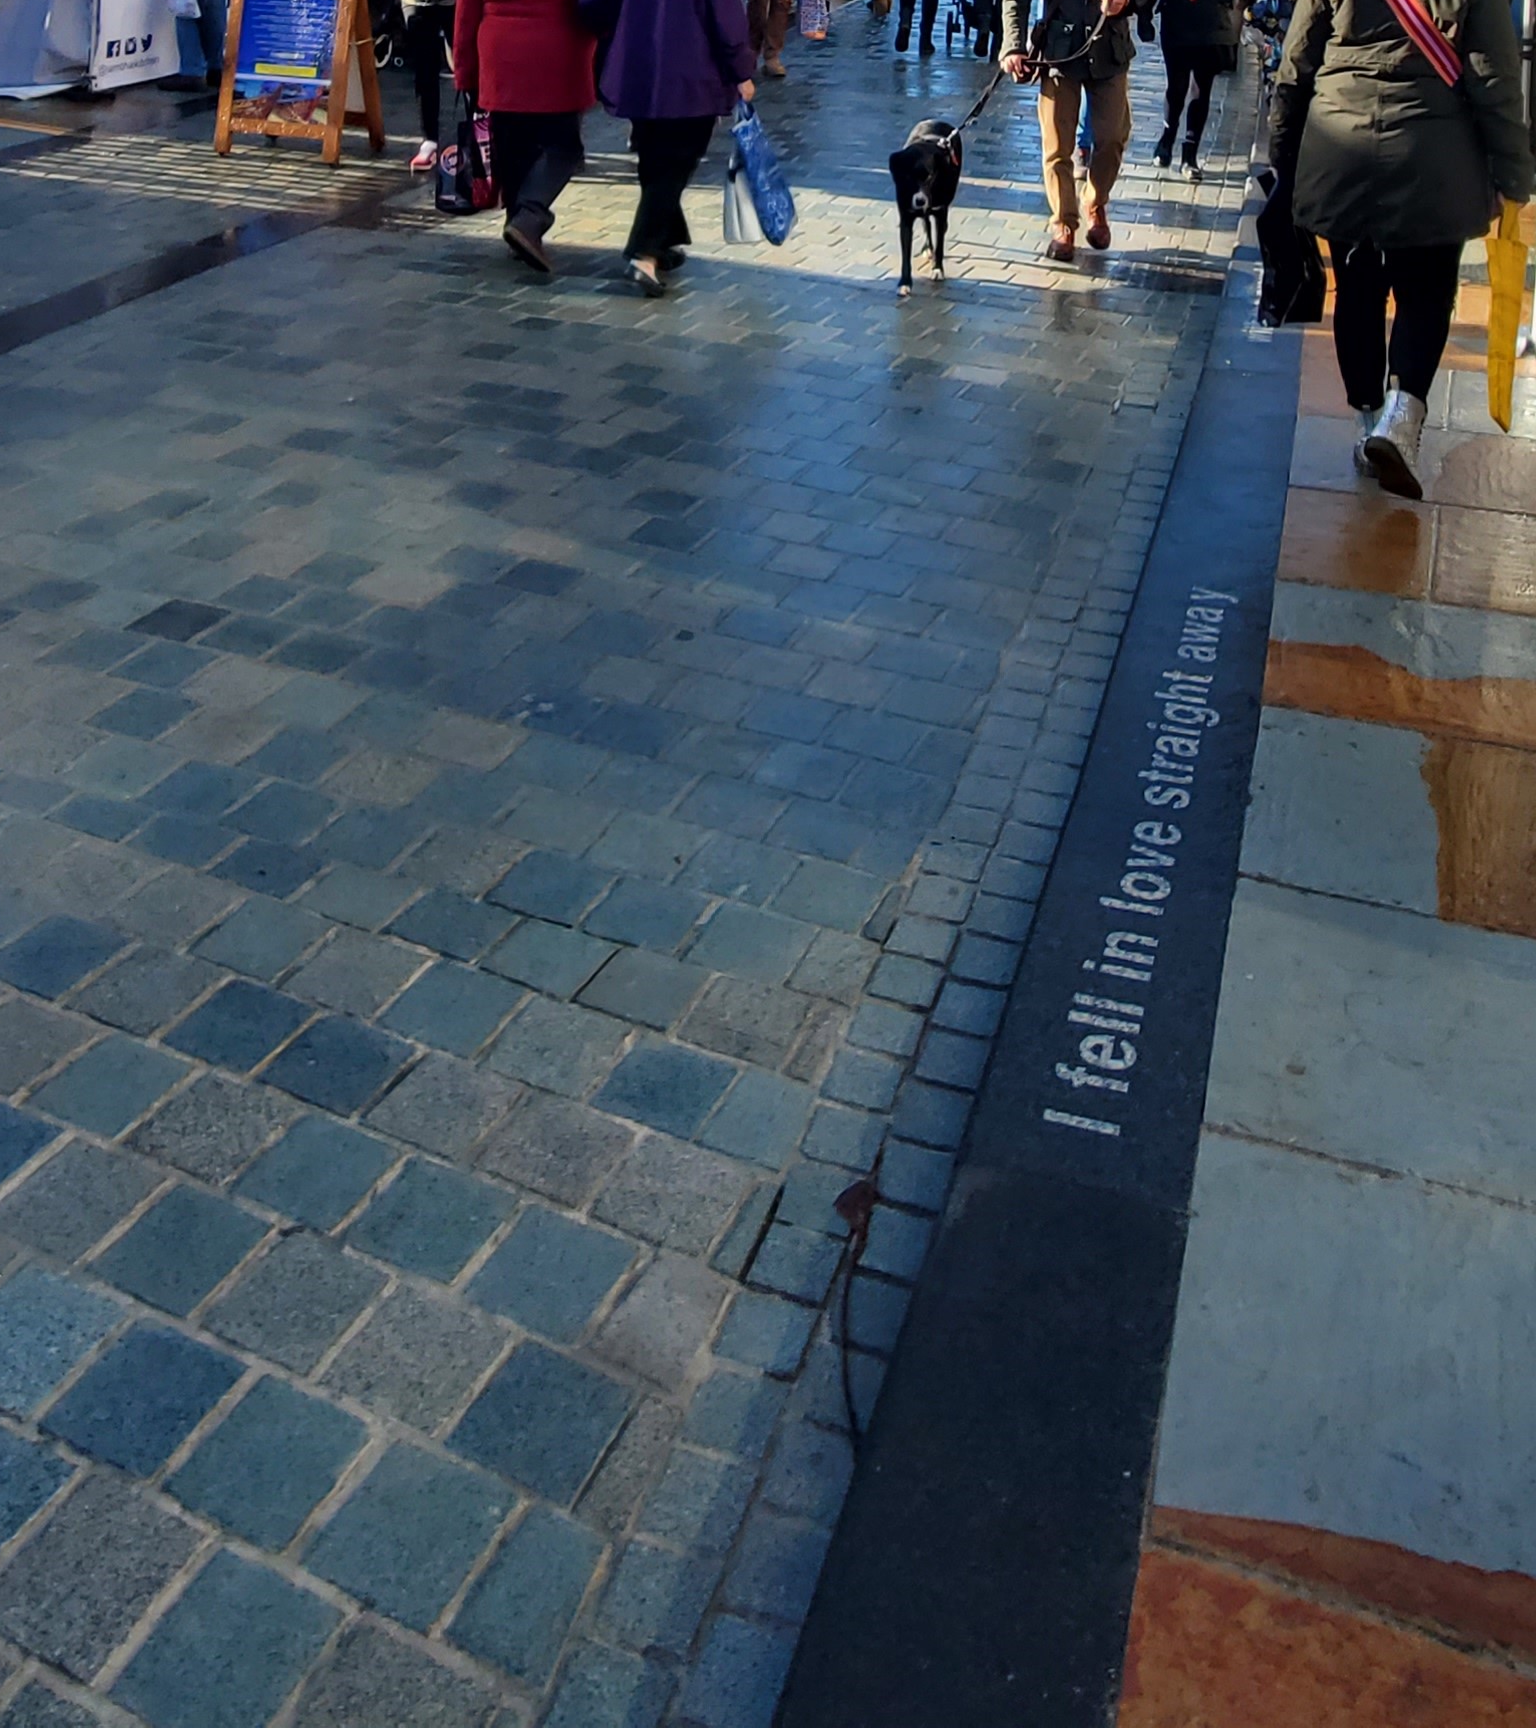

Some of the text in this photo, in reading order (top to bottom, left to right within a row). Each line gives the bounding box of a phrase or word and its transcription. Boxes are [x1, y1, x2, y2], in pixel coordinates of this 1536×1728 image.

[1043, 584, 1241, 1137] I fell in love straight away
